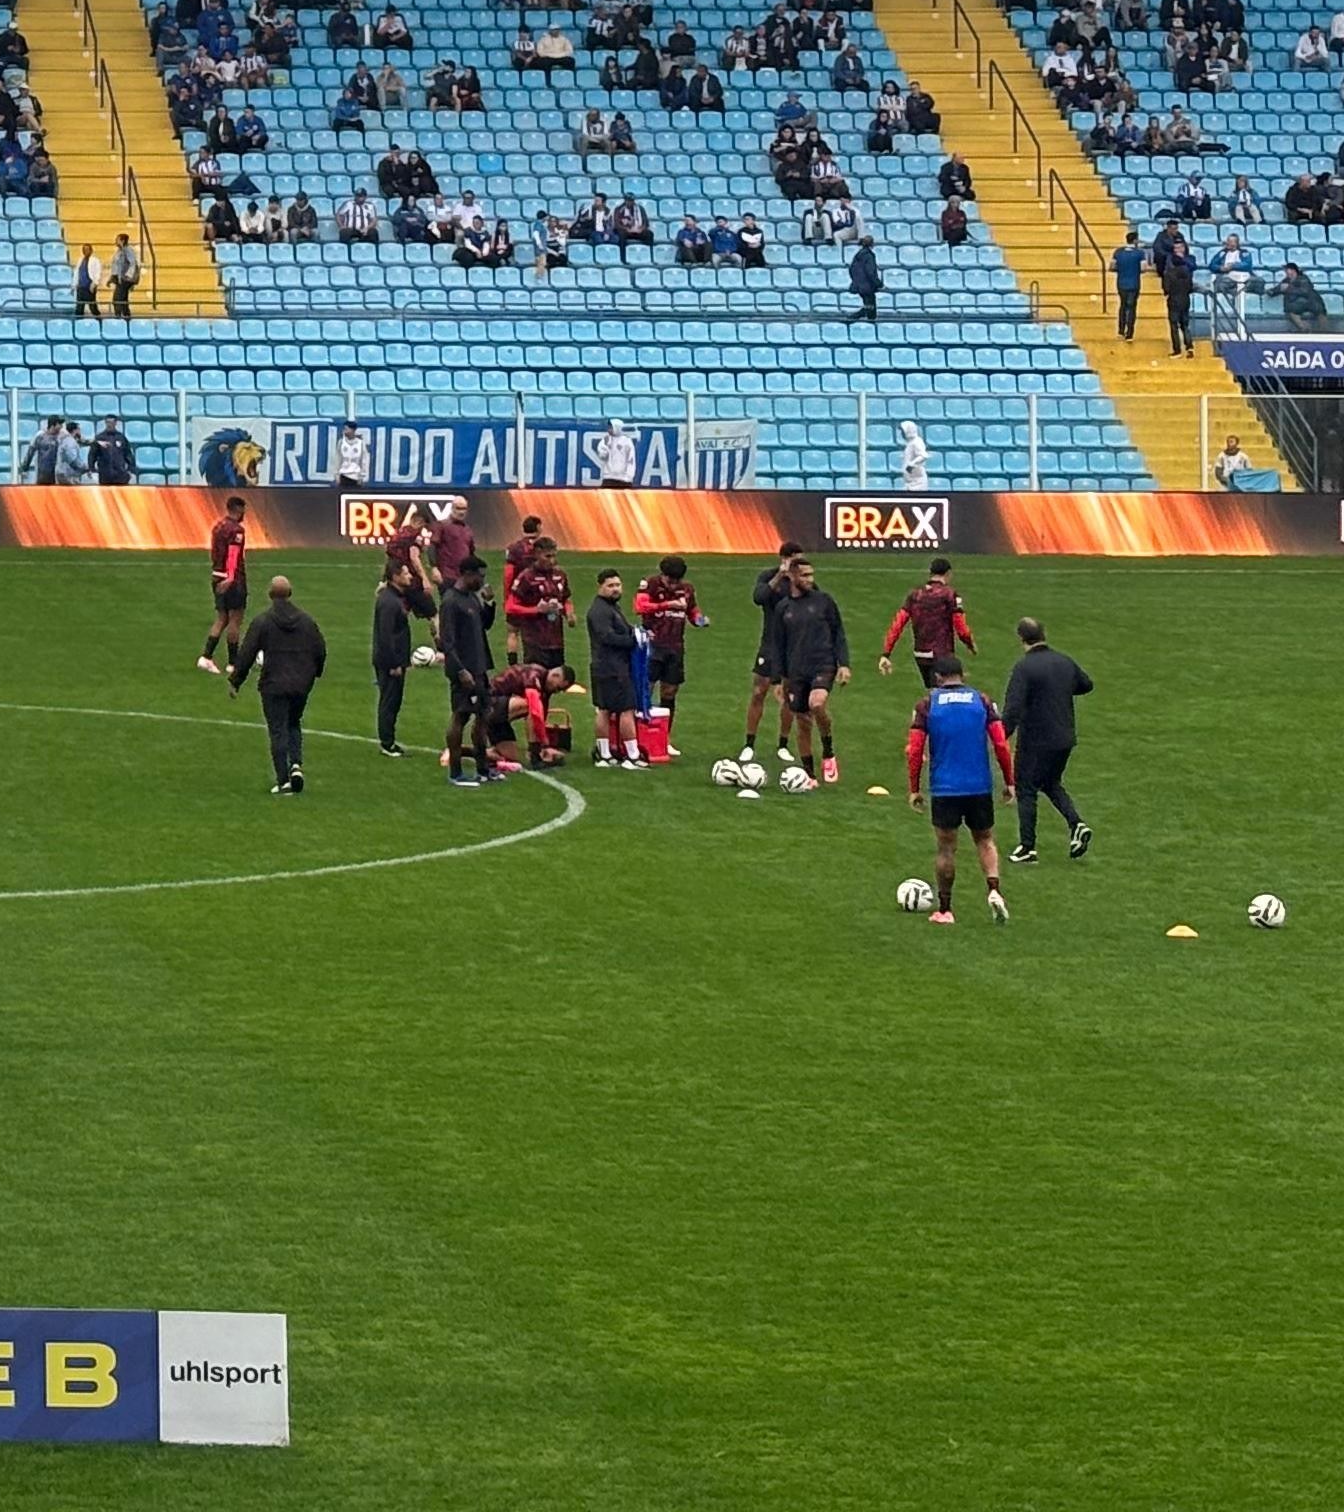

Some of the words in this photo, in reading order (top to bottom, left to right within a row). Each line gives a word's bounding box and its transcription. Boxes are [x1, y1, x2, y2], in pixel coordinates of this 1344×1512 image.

[1261, 345, 1326, 369] SAÍDA
[275, 424, 453, 484] RUIDO
[837, 506, 938, 539] BRAX
[44, 1341, 118, 1409] B
[169, 1359, 280, 1389] uhlsport
